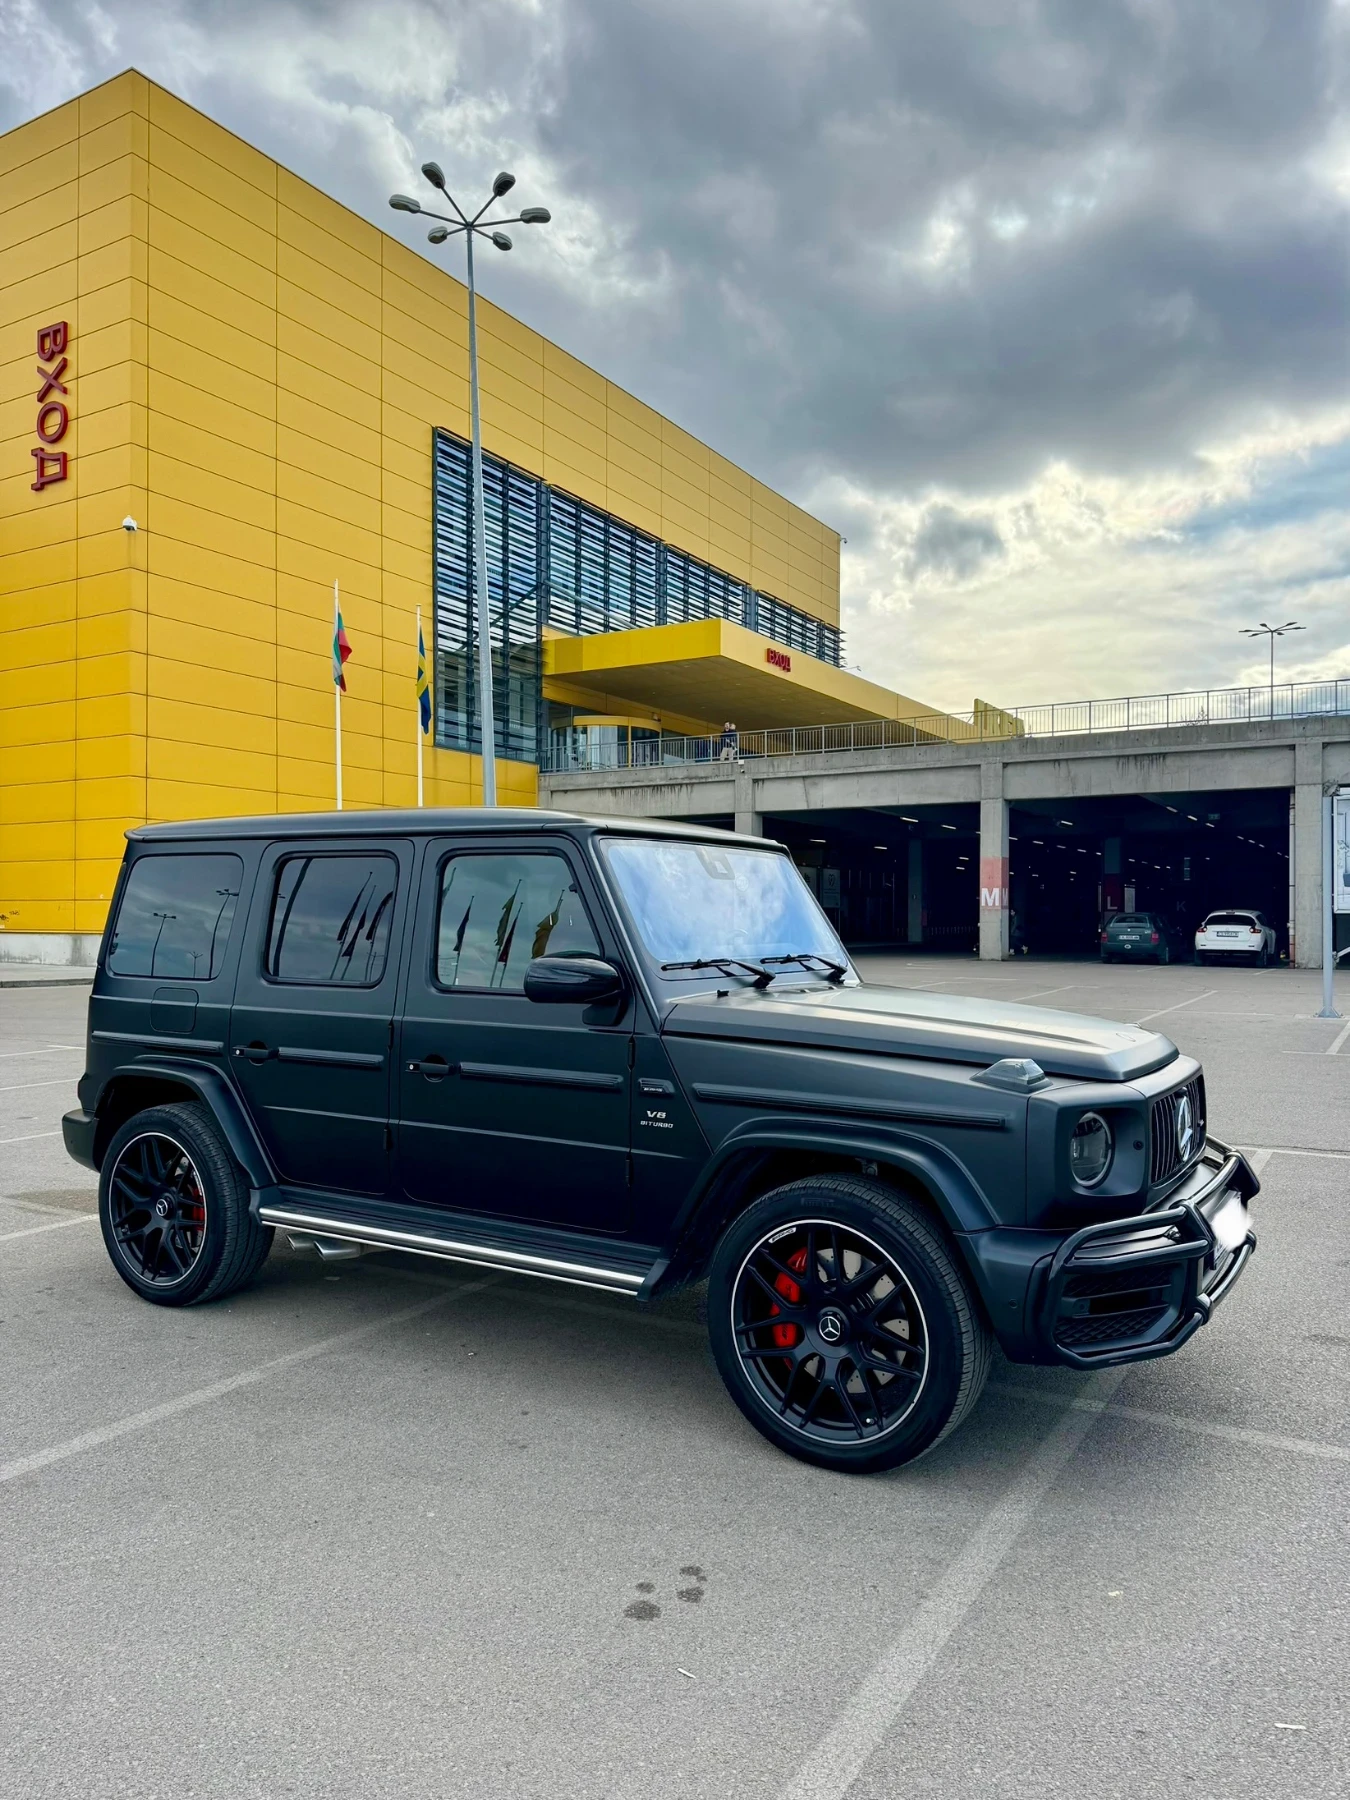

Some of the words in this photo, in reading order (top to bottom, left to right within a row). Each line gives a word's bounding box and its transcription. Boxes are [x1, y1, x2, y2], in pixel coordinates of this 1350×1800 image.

[31, 321, 68, 491] ВХОД
[767, 648, 791, 672] ВХОД
[981, 888, 1000, 907] M
[1107, 896, 1118, 910] L
[1176, 901, 1186, 912] K
[646, 1110, 667, 1119] V8
[640, 1120, 674, 1129] BITURBO
